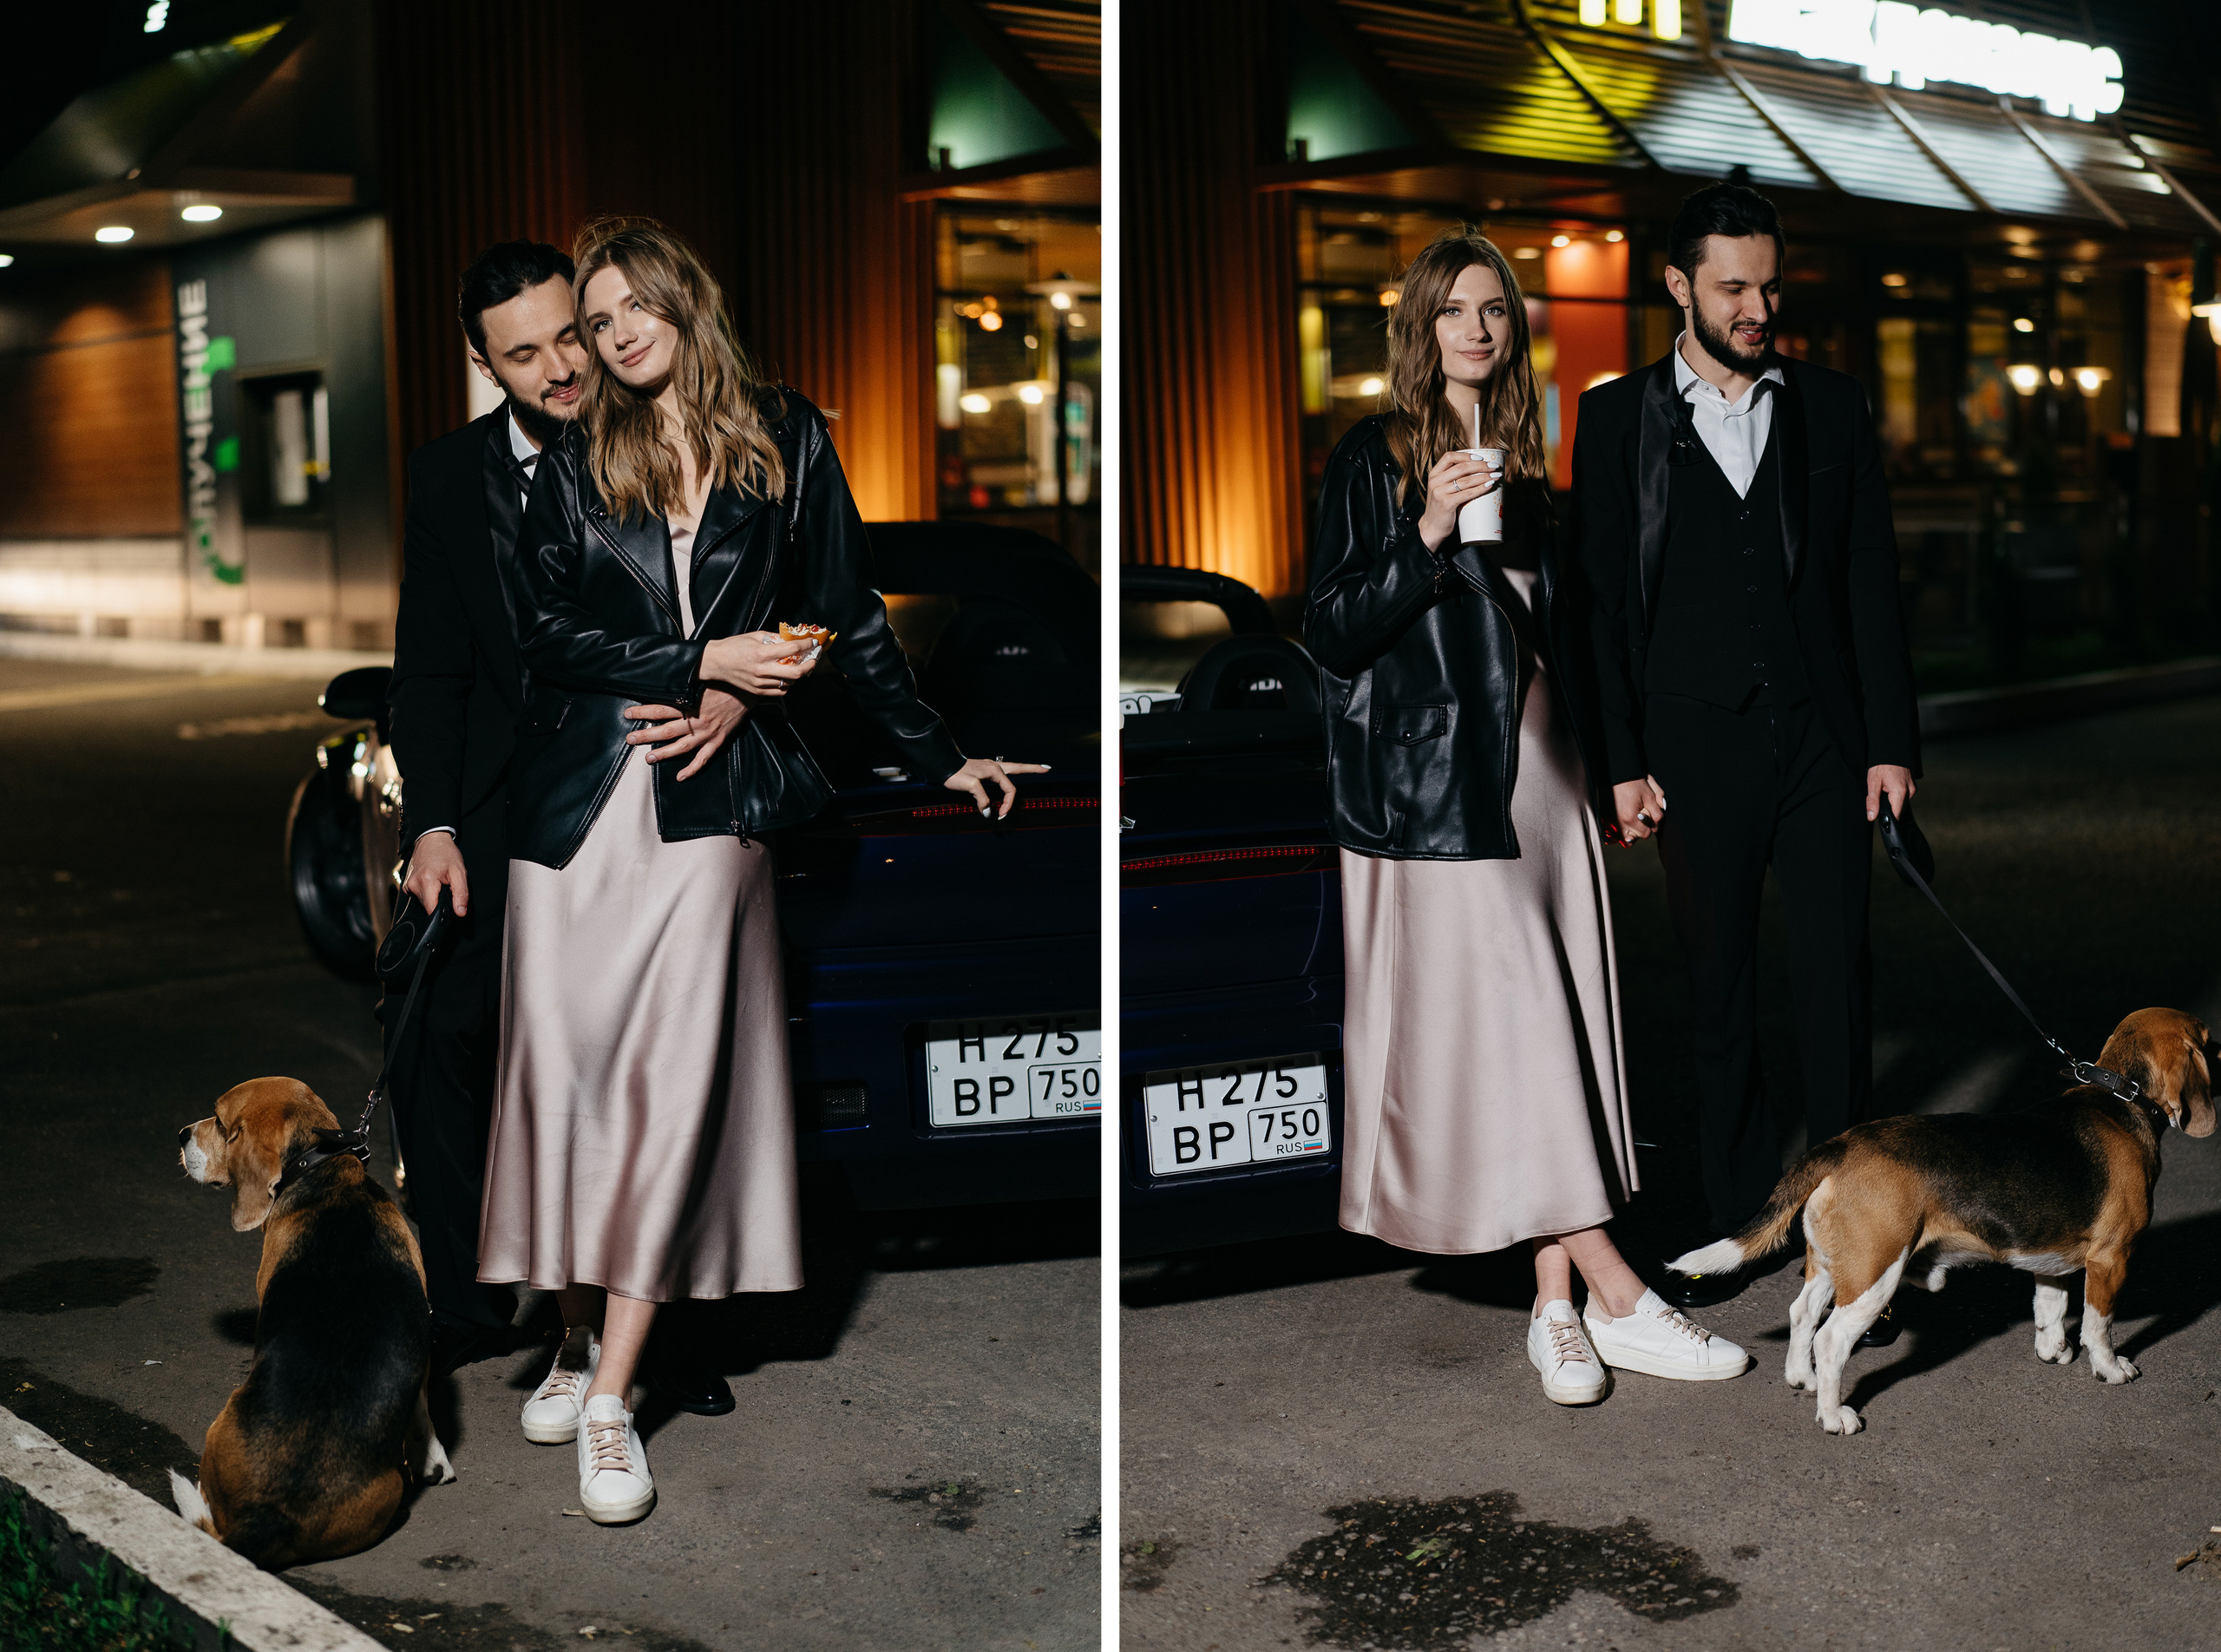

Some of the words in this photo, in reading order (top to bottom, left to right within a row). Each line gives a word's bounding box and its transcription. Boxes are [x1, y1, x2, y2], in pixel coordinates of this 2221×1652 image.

[1001, 1017, 1079, 1060] 275
[1038, 1068, 1100, 1100] 750
[1220, 1059, 1298, 1106] 275
[1055, 1101, 1082, 1113] RUS
[1258, 1108, 1320, 1143] 750
[1276, 1142, 1302, 1155] RUS
